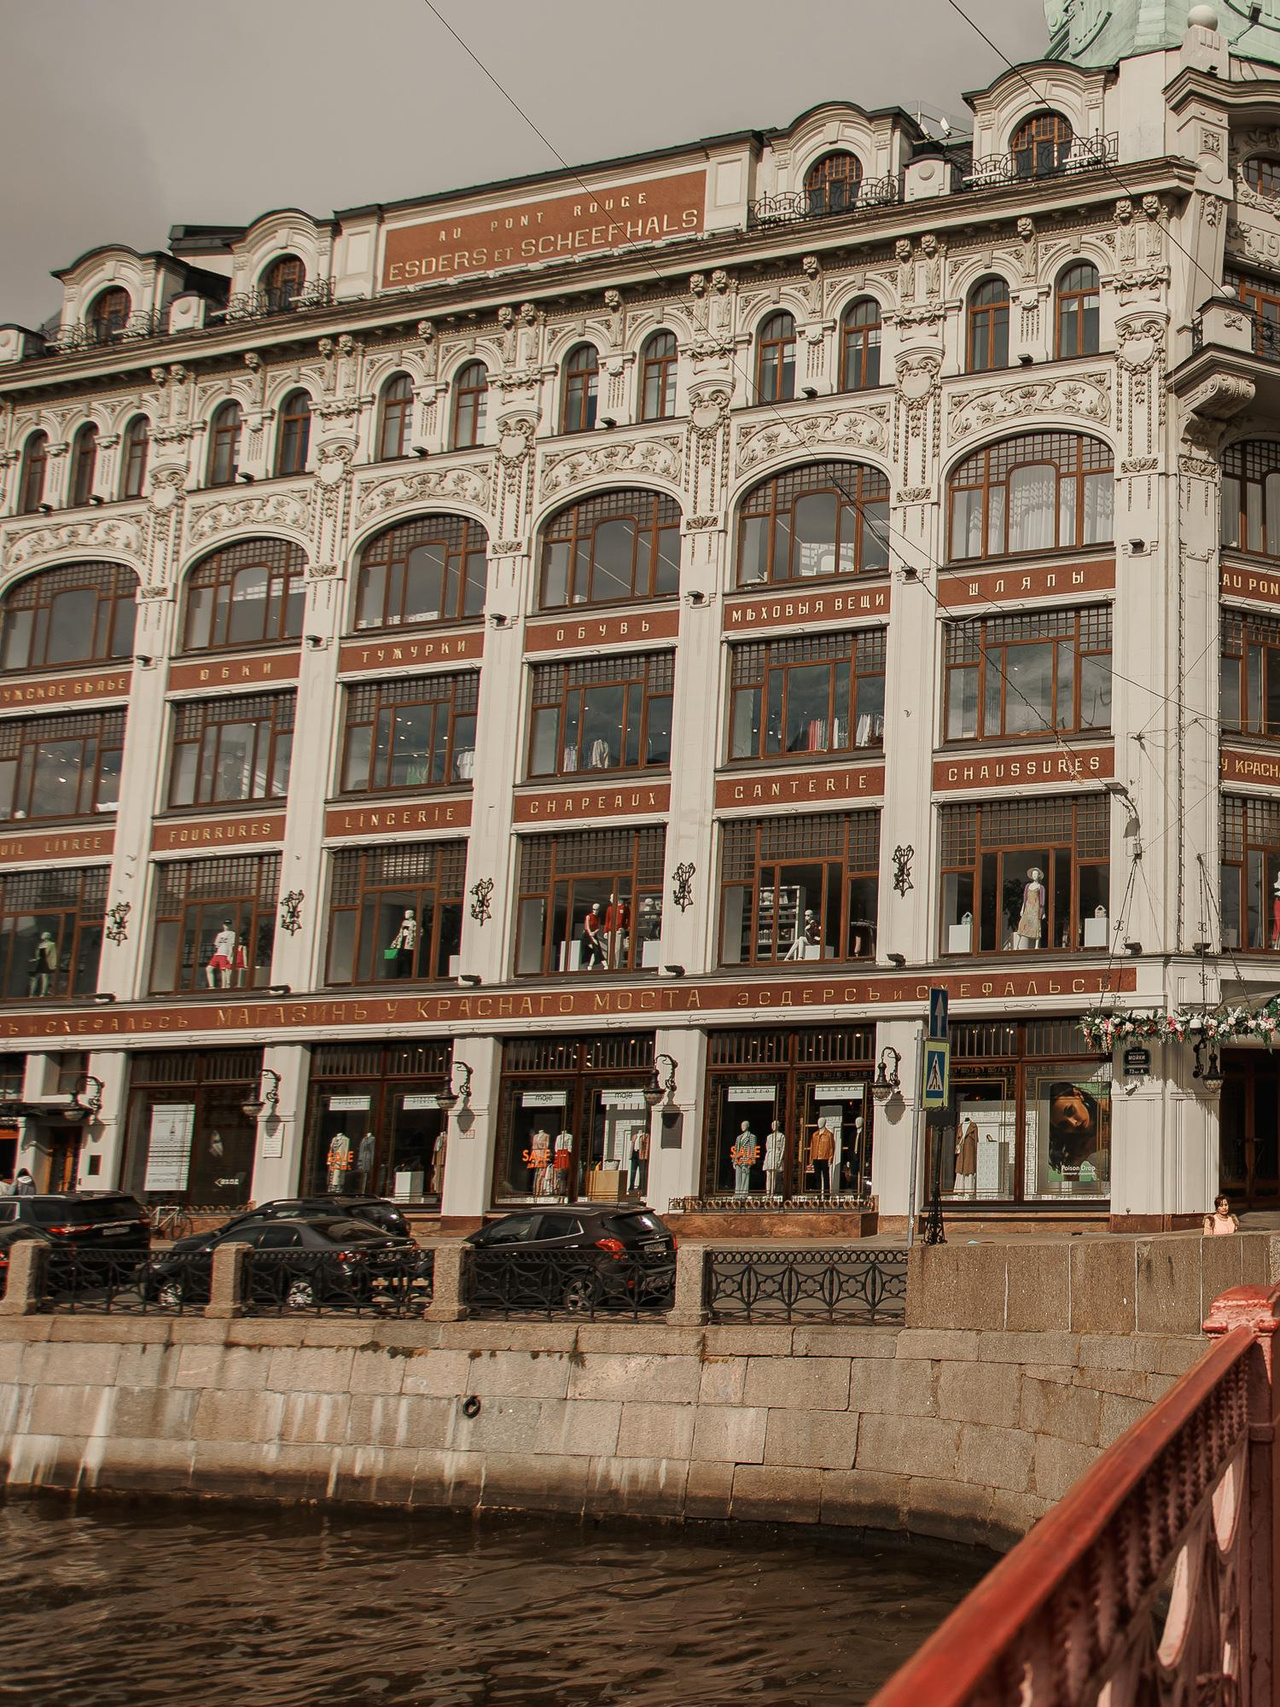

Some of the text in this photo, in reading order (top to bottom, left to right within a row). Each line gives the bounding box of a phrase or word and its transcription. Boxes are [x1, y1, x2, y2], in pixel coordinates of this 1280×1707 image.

[439, 192, 648, 242] AU PONT ROUGE
[389, 208, 699, 282] ESDERS ET SCHEEFHALS
[968, 569, 1085, 597] ШЛЯПЫ
[1222, 573, 1241, 588] AU
[834, 592, 885, 612] ВЕЩИ
[555, 619, 651, 642] ОБУВЬ
[360, 639, 467, 664] ТУЖУРКИ
[200, 661, 272, 682] ЮБКИ
[947, 756, 1101, 782] CHAUSSURES
[1221, 757, 1228, 772] У
[530, 792, 656, 814] CHAPEAUX
[169, 823, 271, 843] FOURRURES
[216, 1002, 368, 1026] МАГАЗИНЪ
[383, 1003, 398, 1019] У
[416, 993, 575, 1018] КРАСНАГО
[593, 989, 702, 1011] МОСТА
[737, 986, 881, 1007] ЭСДЕРСЪ
[522, 1149, 551, 1162] SALE
[730, 1145, 762, 1159] SALE
